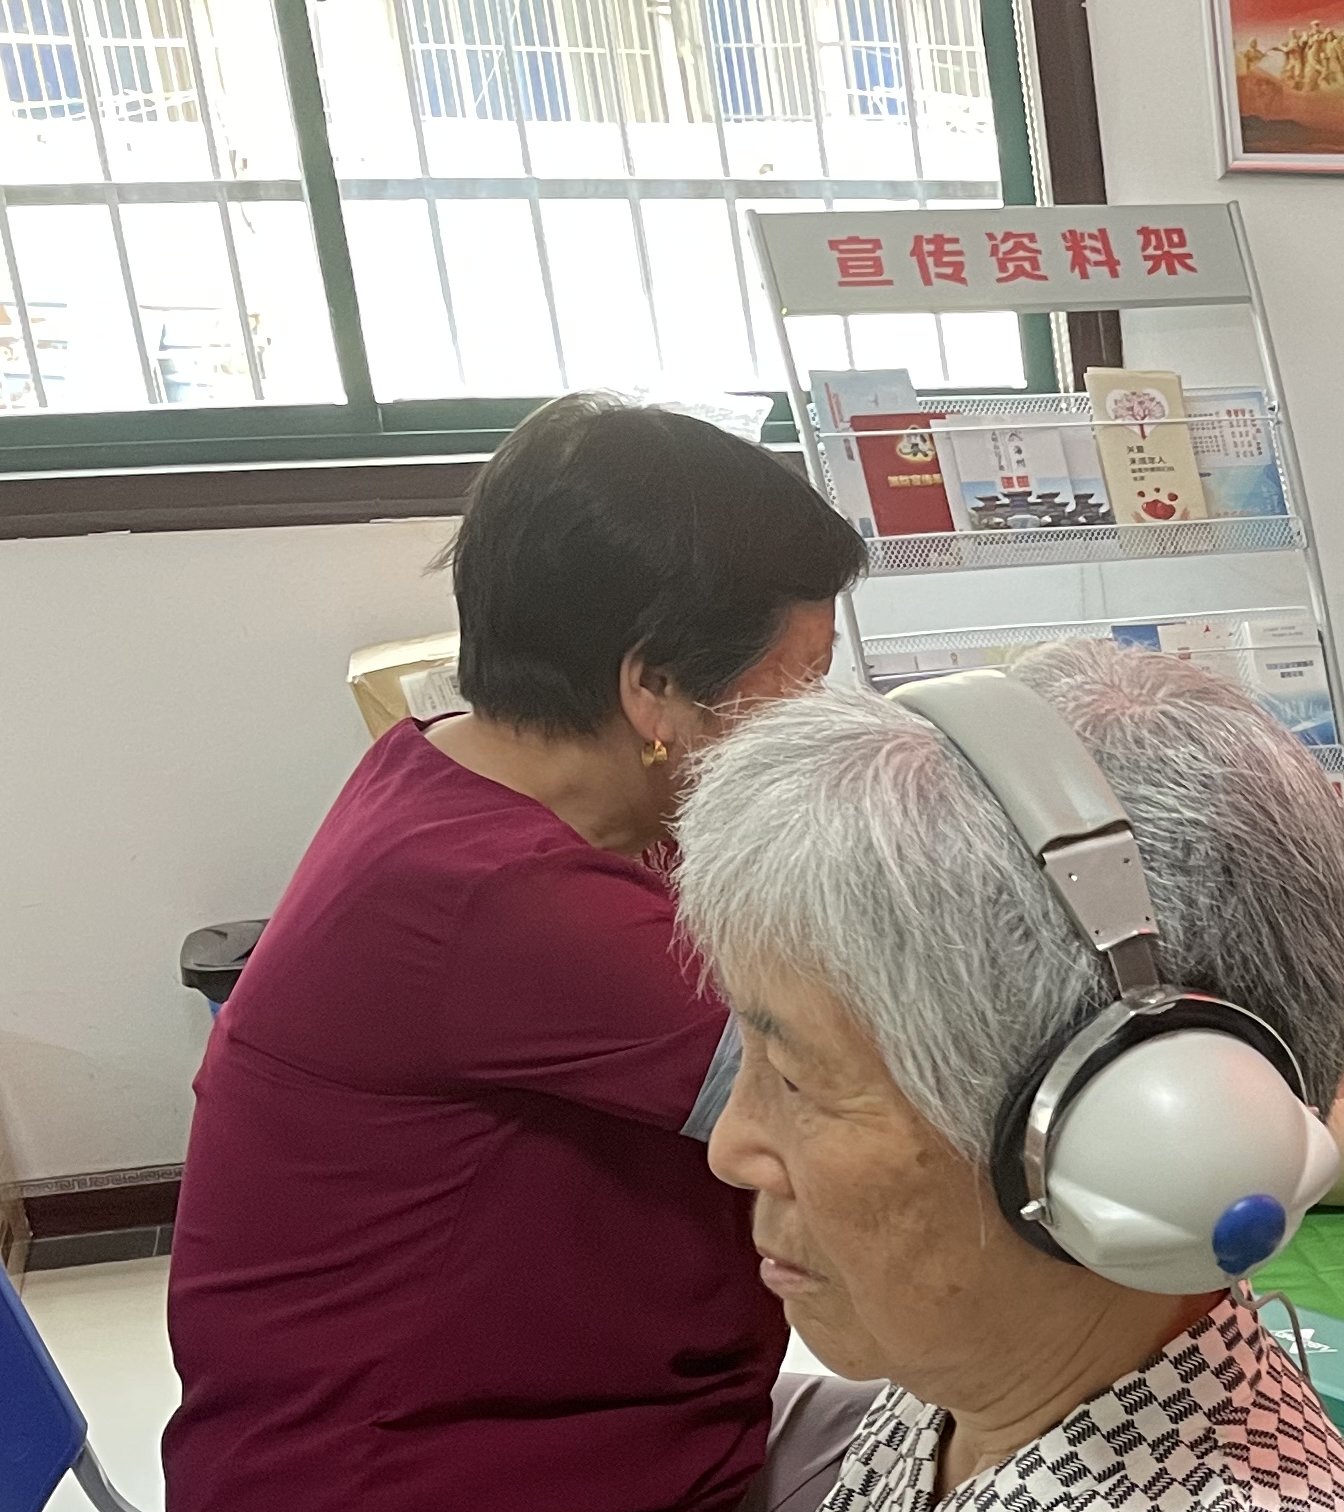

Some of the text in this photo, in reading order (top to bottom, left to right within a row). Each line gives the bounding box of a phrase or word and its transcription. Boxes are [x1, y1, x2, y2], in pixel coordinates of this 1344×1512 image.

[827, 225, 1199, 288] 宣传资料架
